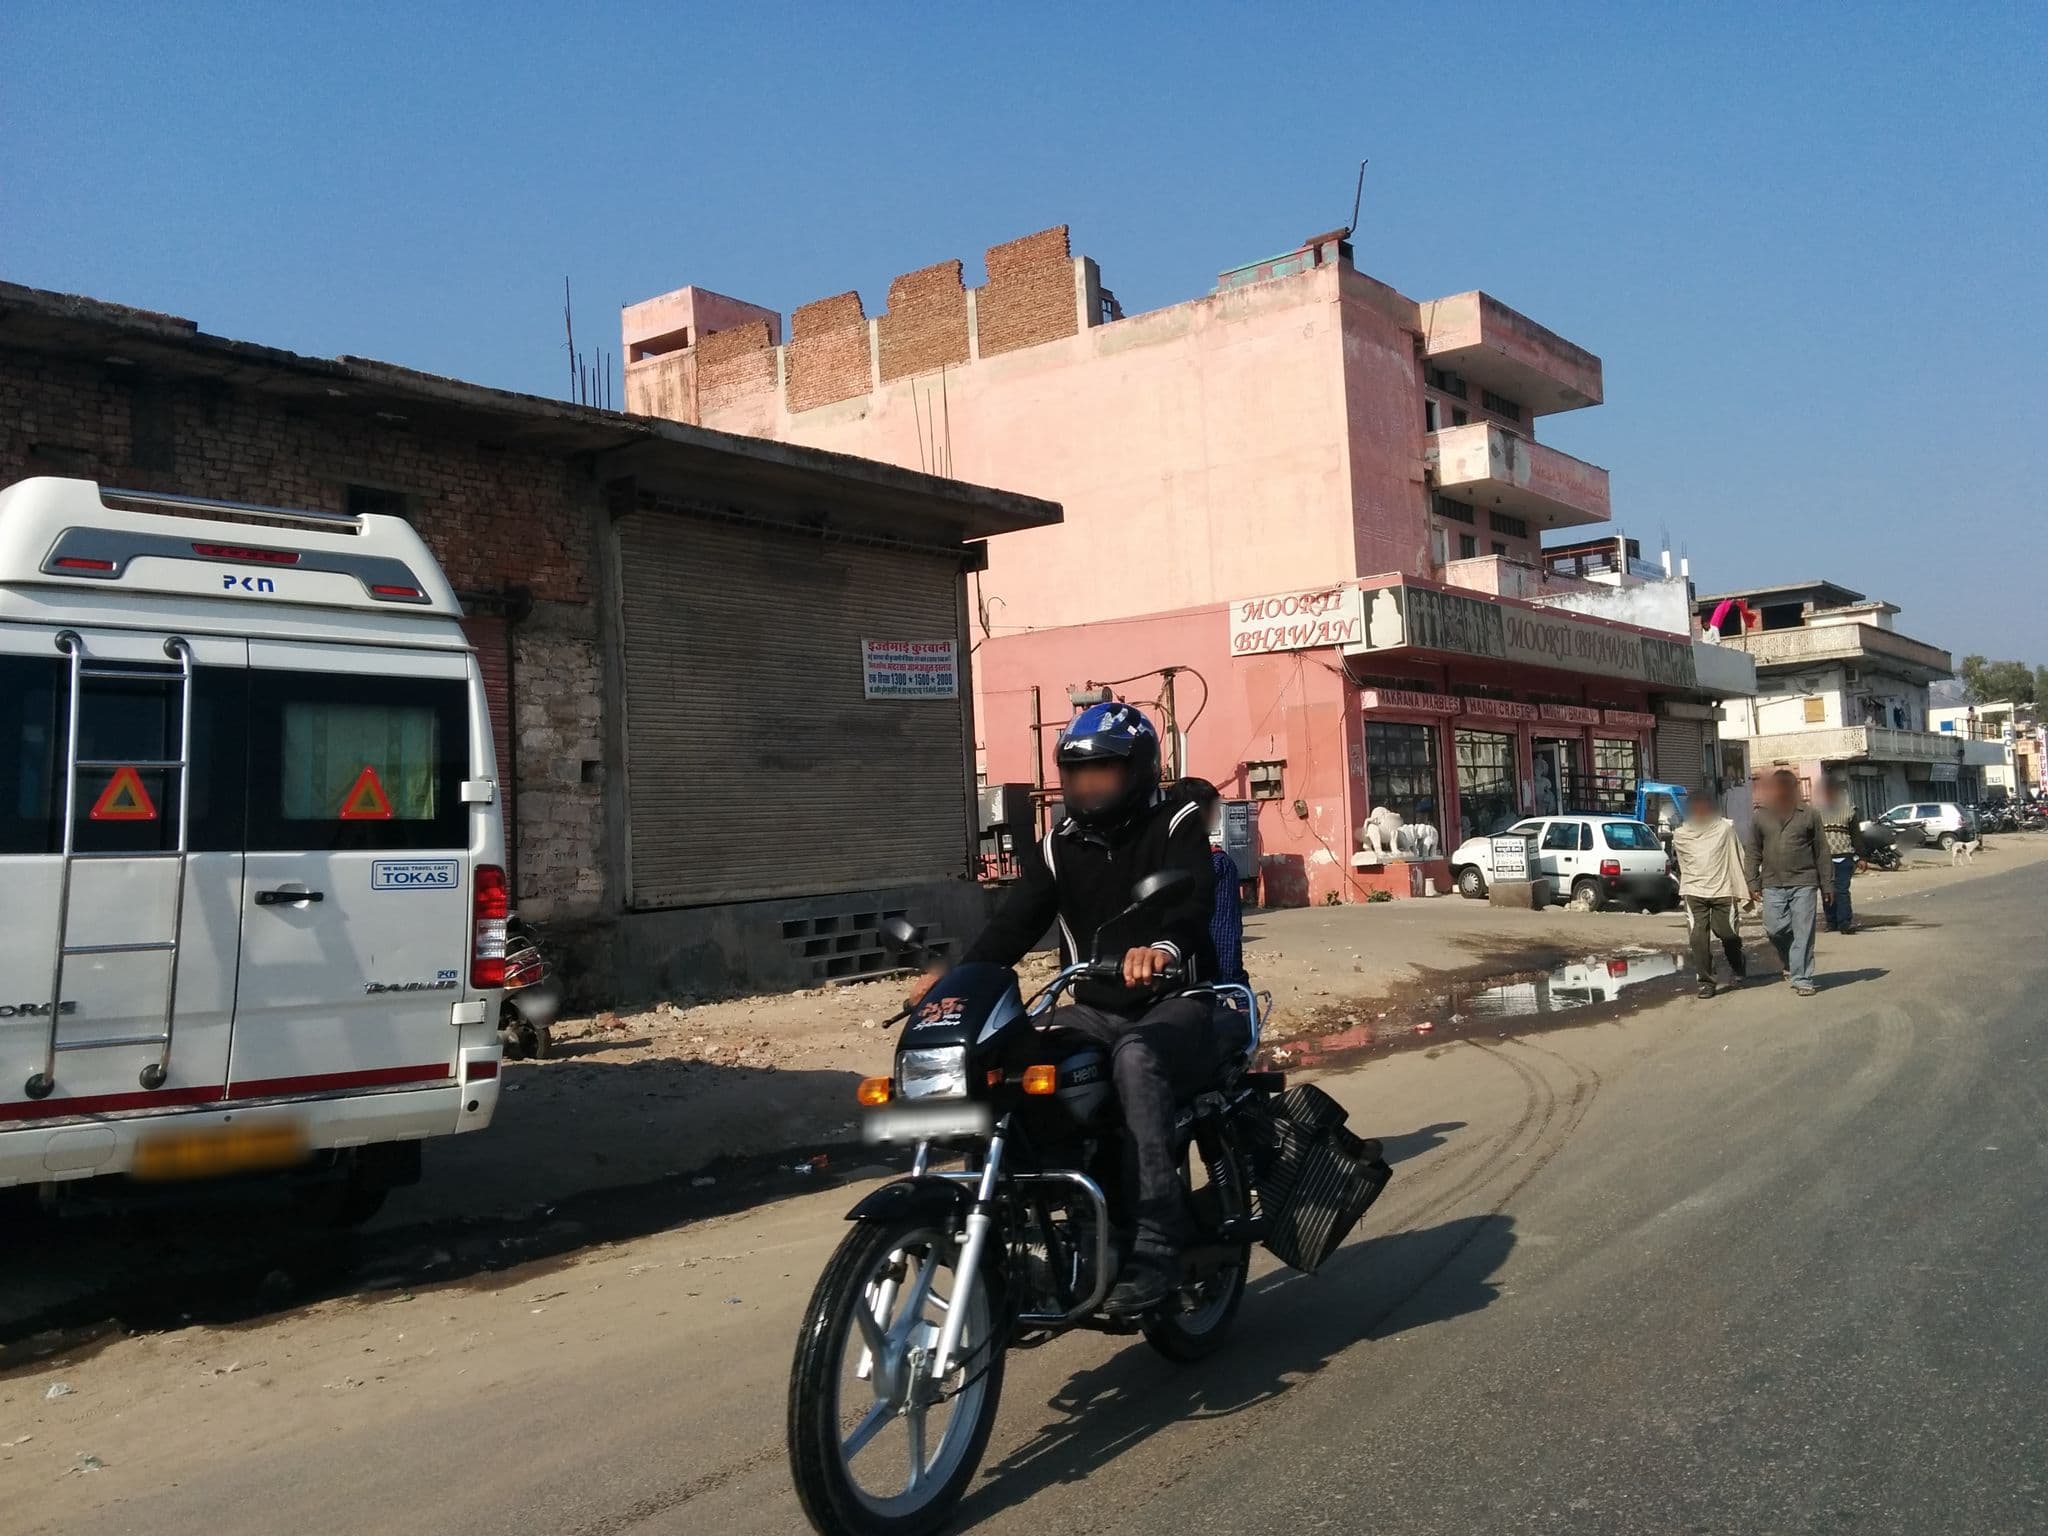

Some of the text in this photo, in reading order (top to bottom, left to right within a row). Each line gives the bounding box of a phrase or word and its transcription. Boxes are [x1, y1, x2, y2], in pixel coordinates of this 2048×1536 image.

[1235, 618, 1358, 651] BHAWAN
[1574, 630, 1640, 669] BHAWAN
[891, 673, 907, 685] 1300
[1422, 694, 1460, 711] MARBLES
[383, 872, 449, 884] TOKAS
